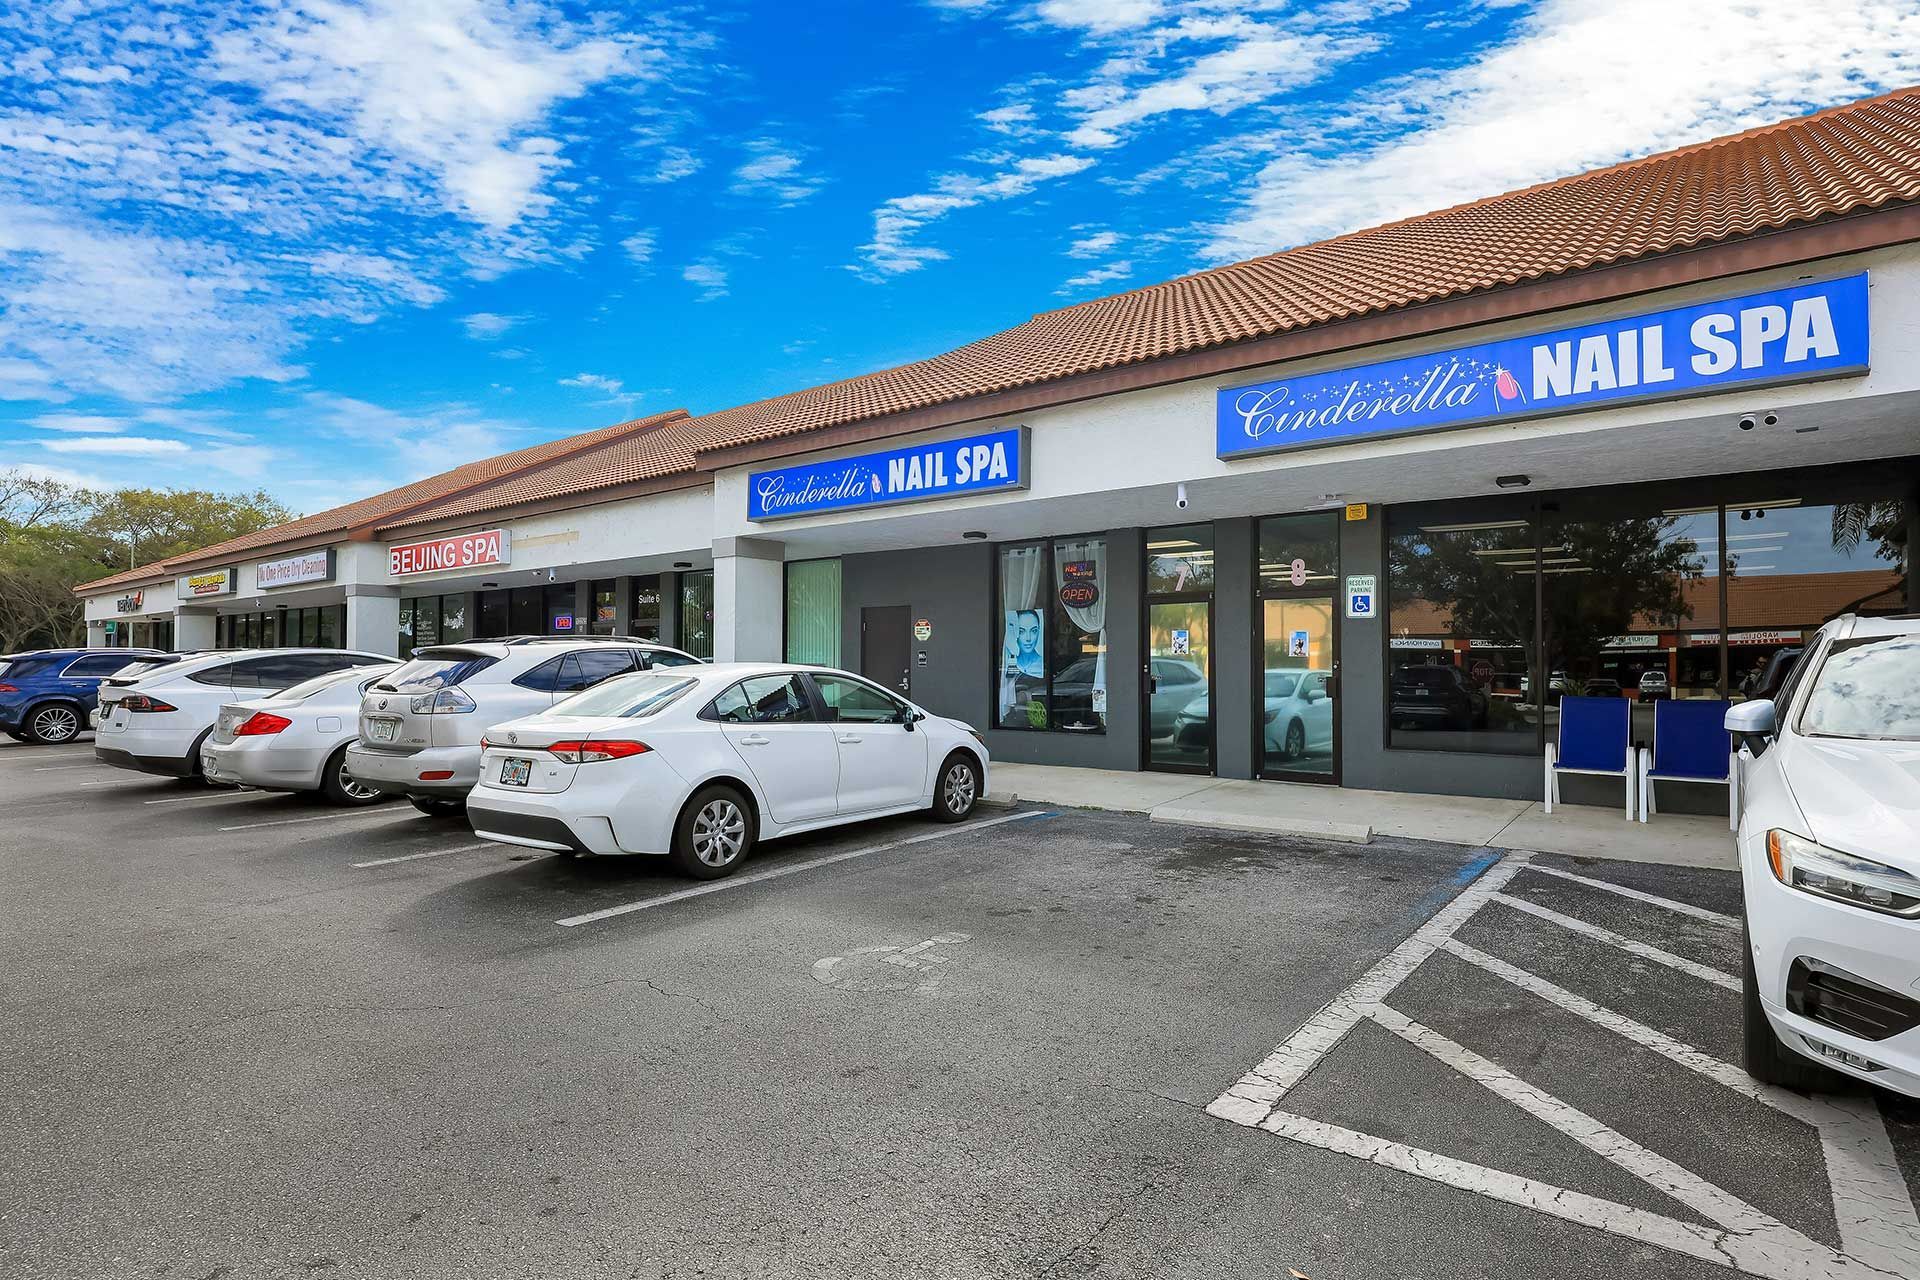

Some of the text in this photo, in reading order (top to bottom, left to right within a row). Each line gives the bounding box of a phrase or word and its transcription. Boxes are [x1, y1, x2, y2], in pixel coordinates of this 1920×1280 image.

[1235, 295, 1840, 440] Cinderella NAIL SPA
[757, 442, 1008, 515] Cinderella NAIL SPA
[277, 563, 290, 579] Price
[291, 561, 301, 579] Dry
[302, 557, 326, 576] Cleaning
[390, 536, 500, 574] BEIJING SPA
[1175, 563, 1190, 591] 7
[1291, 558, 1306, 587] 8
[639, 594, 661, 603] Suite 6
[1062, 588, 1094, 600] OPEN
